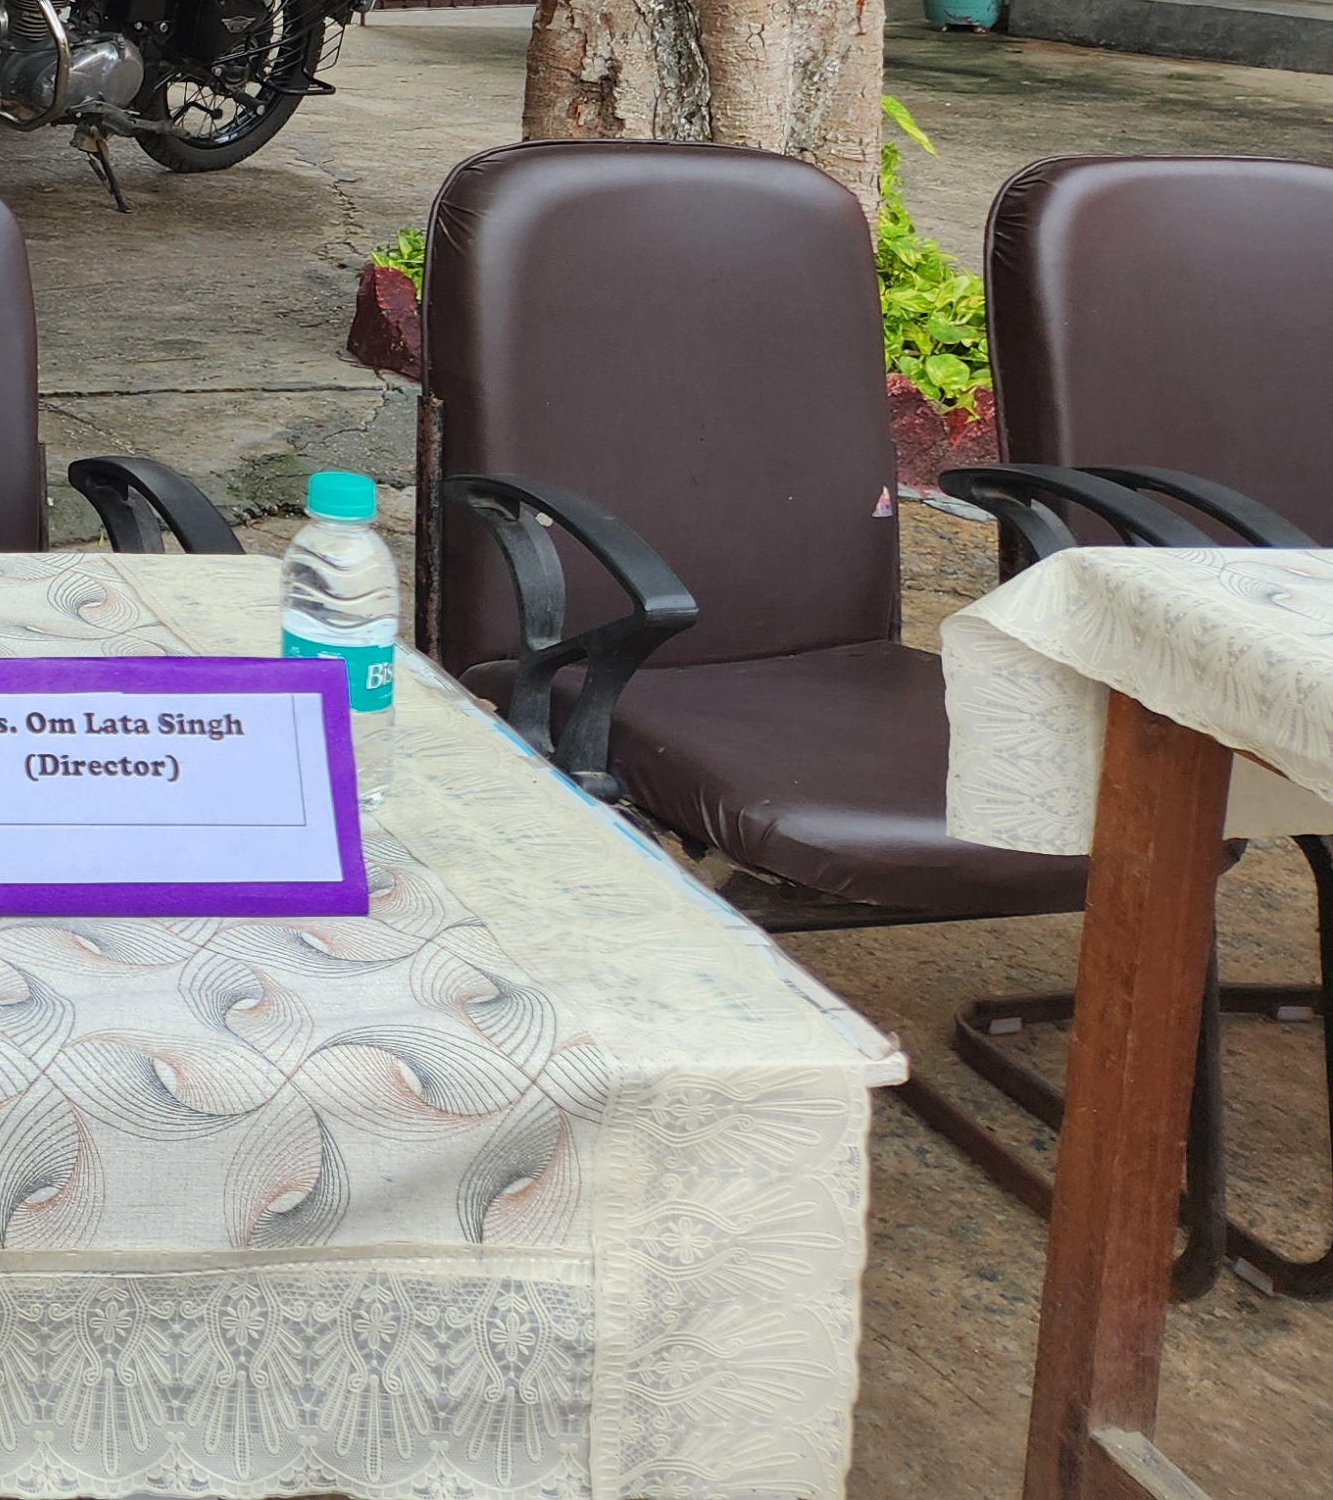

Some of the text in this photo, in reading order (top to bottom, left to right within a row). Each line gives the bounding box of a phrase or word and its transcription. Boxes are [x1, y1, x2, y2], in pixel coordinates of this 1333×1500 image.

[26, 711, 76, 734] Om
[83, 712, 150, 734] Lata
[158, 713, 244, 741] Singh
[25, 753, 179, 782] (Director)
